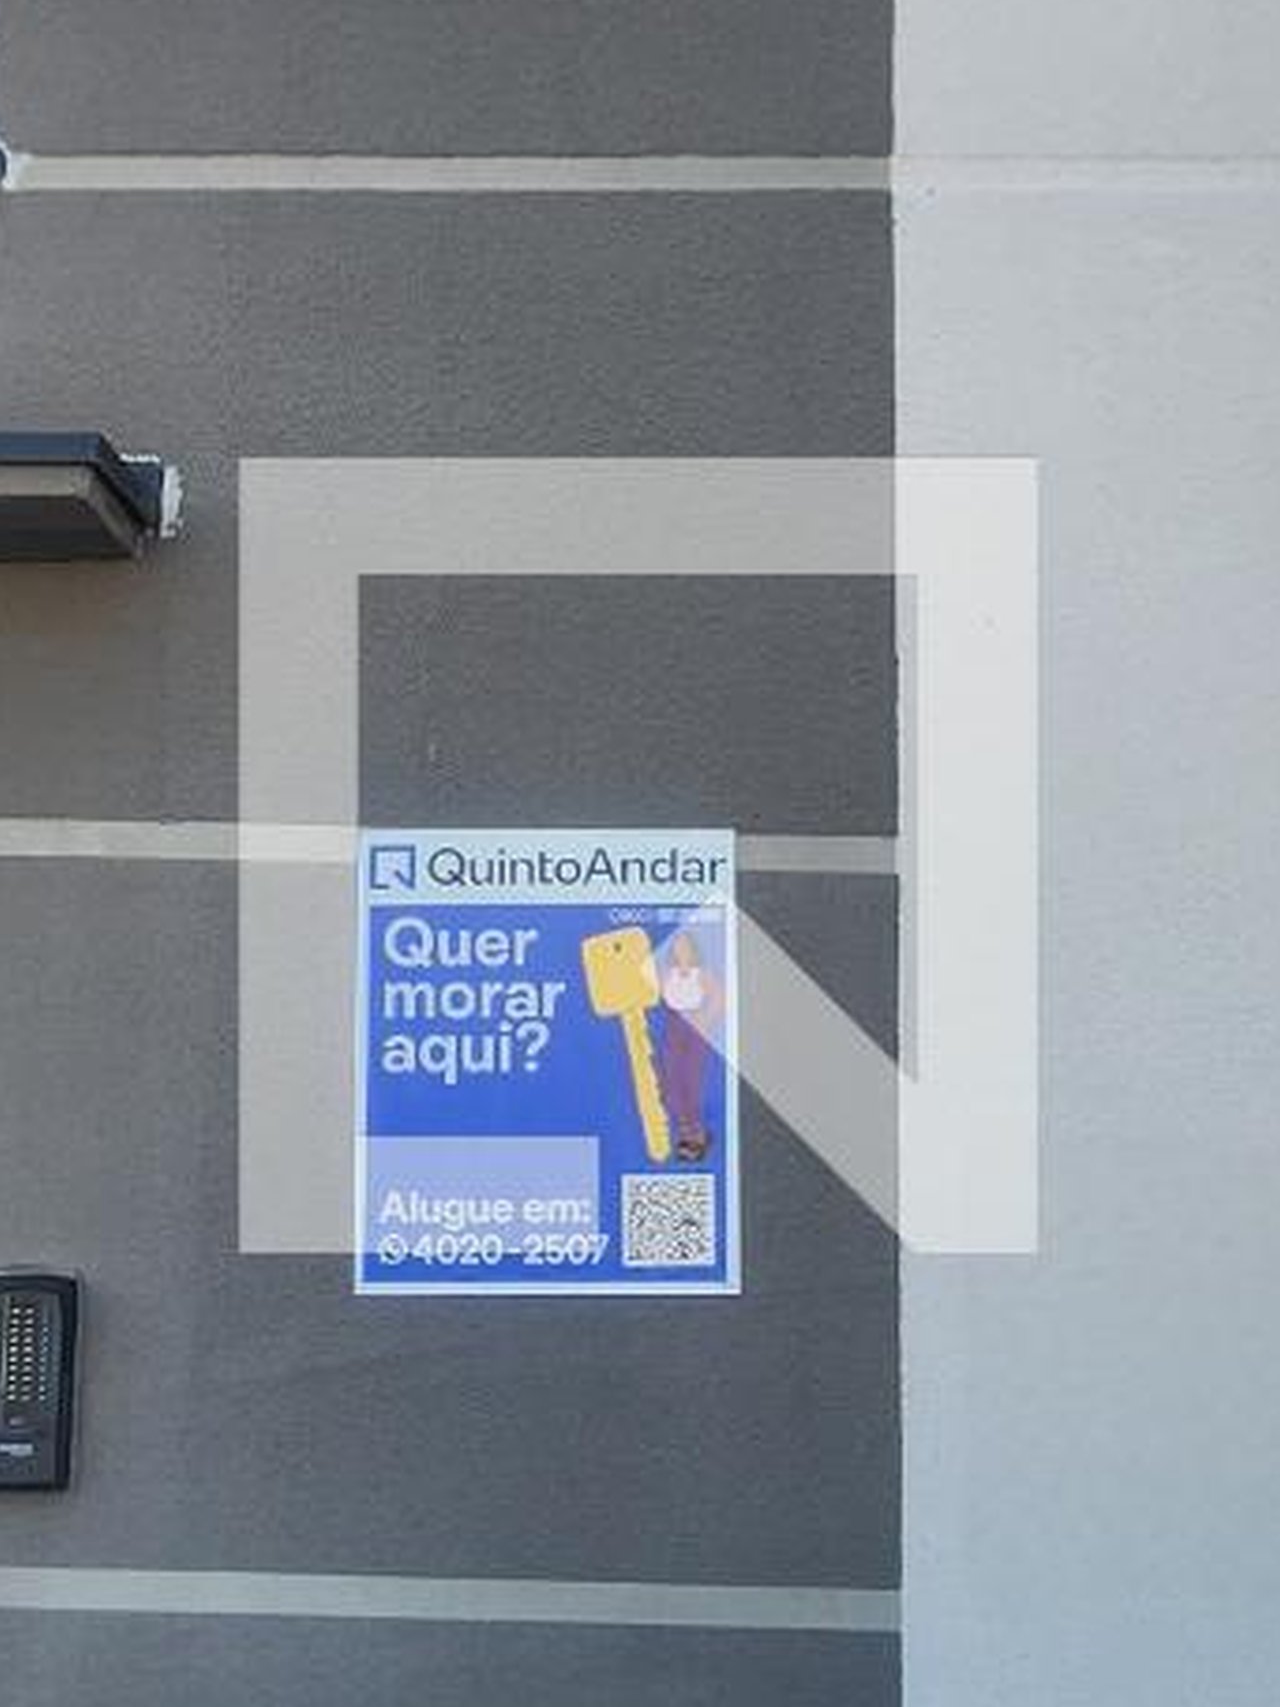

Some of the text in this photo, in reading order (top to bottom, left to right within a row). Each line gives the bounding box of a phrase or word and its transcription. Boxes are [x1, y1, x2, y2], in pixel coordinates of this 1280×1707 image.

[427, 847, 725, 886] QuintoAndar
[384, 917, 538, 968] Quer
[384, 981, 566, 1019] morar
[382, 1021, 550, 1085] aqui?
[378, 1193, 593, 1231] Alugue em:
[411, 1233, 609, 1265] 4020-2507
